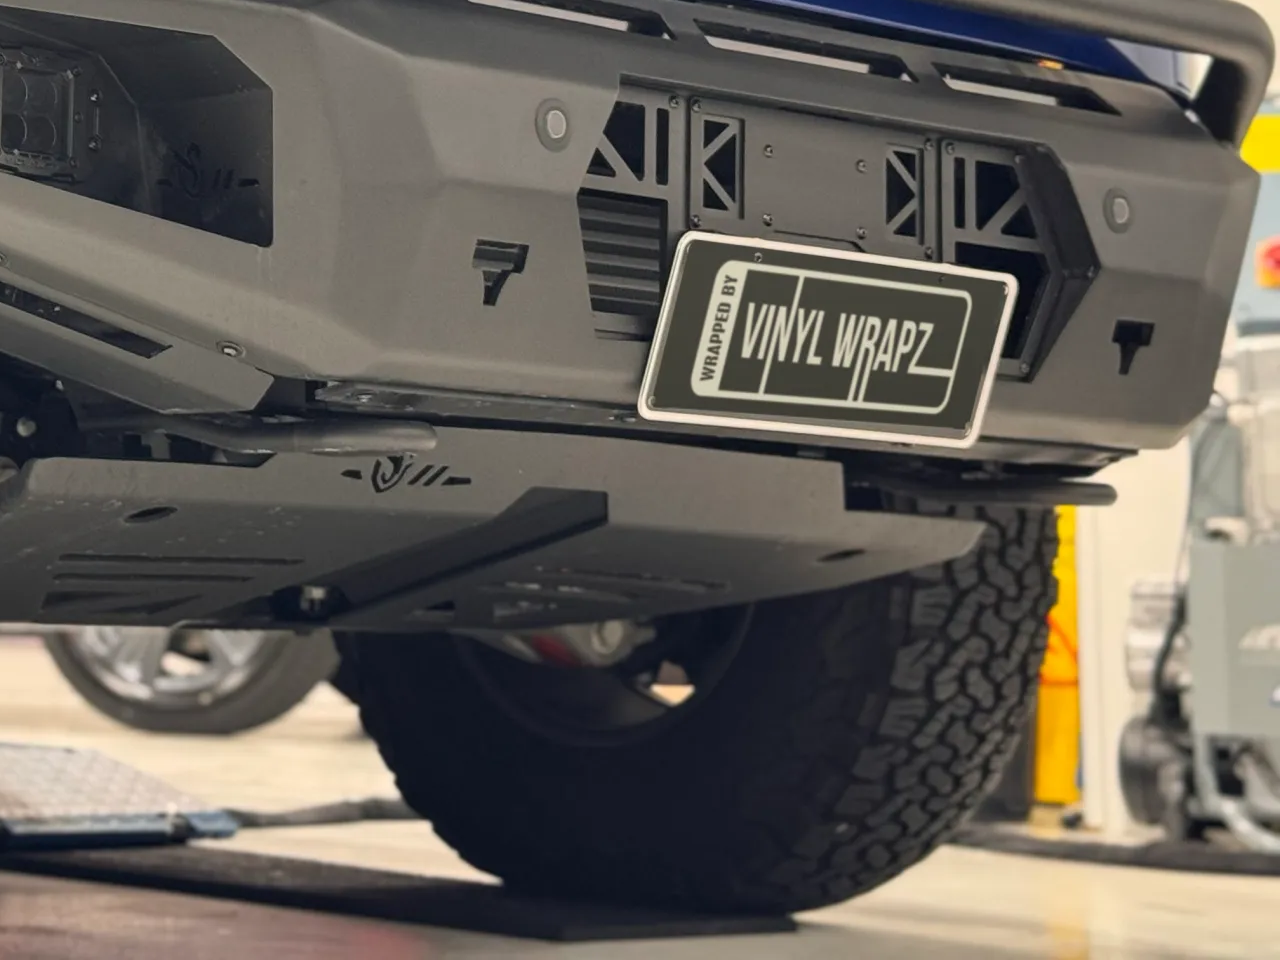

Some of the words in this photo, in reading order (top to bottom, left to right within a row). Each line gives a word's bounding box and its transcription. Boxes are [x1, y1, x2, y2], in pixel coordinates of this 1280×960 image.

[699, 301, 732, 382] WRAPPED
[722, 274, 739, 297] BY
[740, 296, 825, 370] VINYL
[831, 311, 936, 379] WRAPZ
